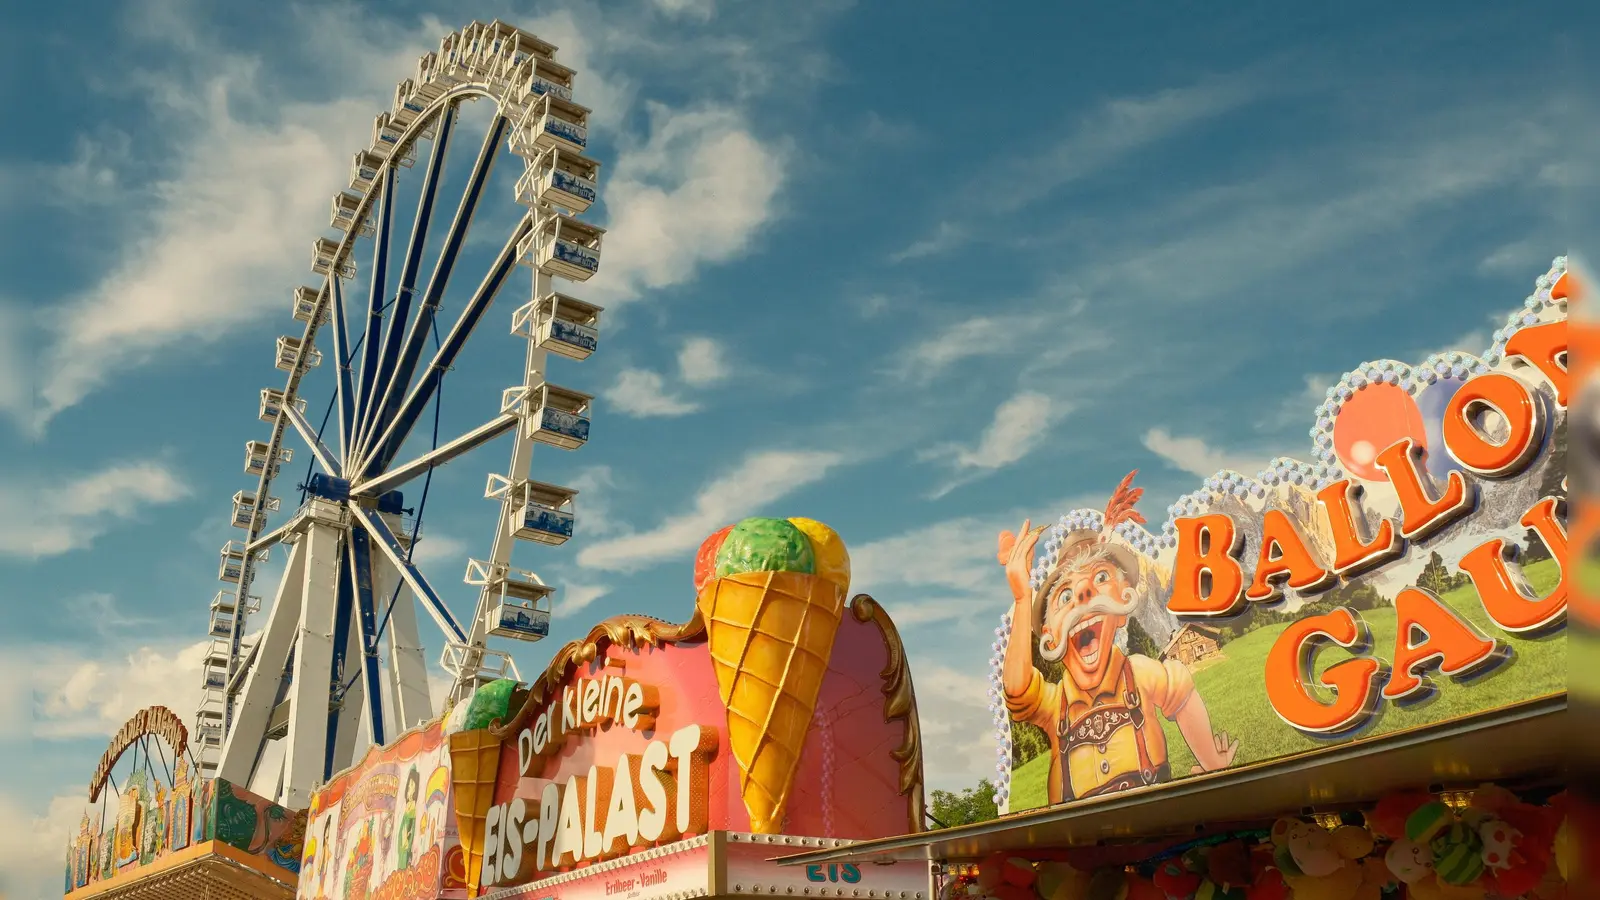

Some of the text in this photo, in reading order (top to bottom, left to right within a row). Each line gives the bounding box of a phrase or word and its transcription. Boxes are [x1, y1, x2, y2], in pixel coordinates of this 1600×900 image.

[1167, 270, 1568, 616] BALLO
[1264, 473, 1568, 733] GAU
[480, 724, 701, 887] EIS-PALAST
[518, 700, 556, 777] Der
